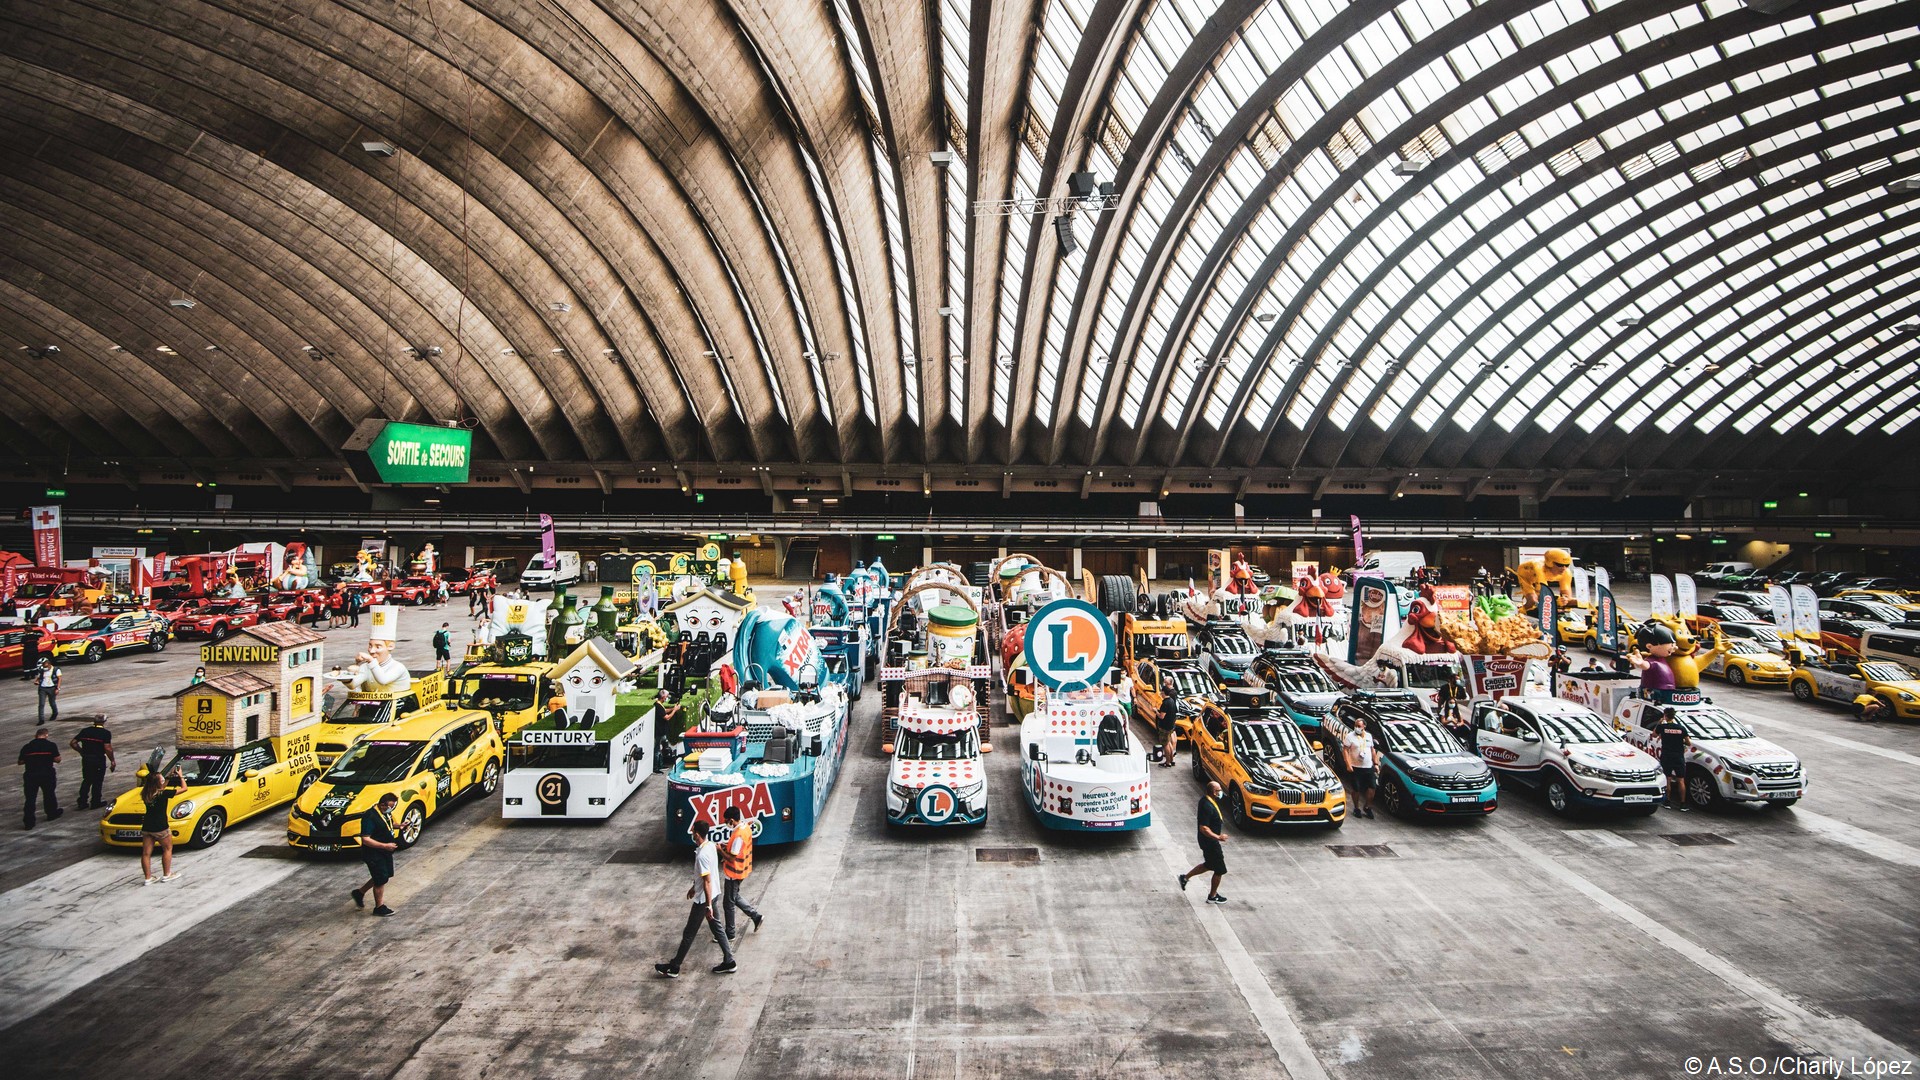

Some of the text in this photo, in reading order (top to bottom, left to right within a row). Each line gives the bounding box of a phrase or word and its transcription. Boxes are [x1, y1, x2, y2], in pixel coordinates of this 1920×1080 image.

[387, 440, 466, 468] SORTIE de SECOURS
[813, 604, 832, 615] XTRA
[200, 646, 279, 662] BIENVENUE
[783, 628, 811, 677] XTRA
[1047, 624, 1085, 671] L
[1490, 661, 1523, 671] Gaulois
[422, 683, 439, 698] 2400
[1485, 682, 1516, 691] CHICKEN
[421, 694, 439, 707] LOGIS
[1561, 691, 1585, 705] HARIBO
[187, 715, 222, 735] Logis
[286, 733, 311, 748] PLUS DE
[523, 732, 593, 744] CENTURY
[622, 720, 645, 747] CENTURY
[287, 742, 311, 759] 2400
[1485, 745, 1518, 762] Gaulois
[288, 754, 313, 770] LOGIS
[289, 763, 315, 777] EN EUROPE
[438, 777, 450, 792] PUGET
[546, 783, 562, 797] 21
[320, 799, 351, 808] PUGET
[1082, 792, 1109, 800] Heureux
[689, 782, 775, 832] XTRA
[927, 795, 944, 817] L
